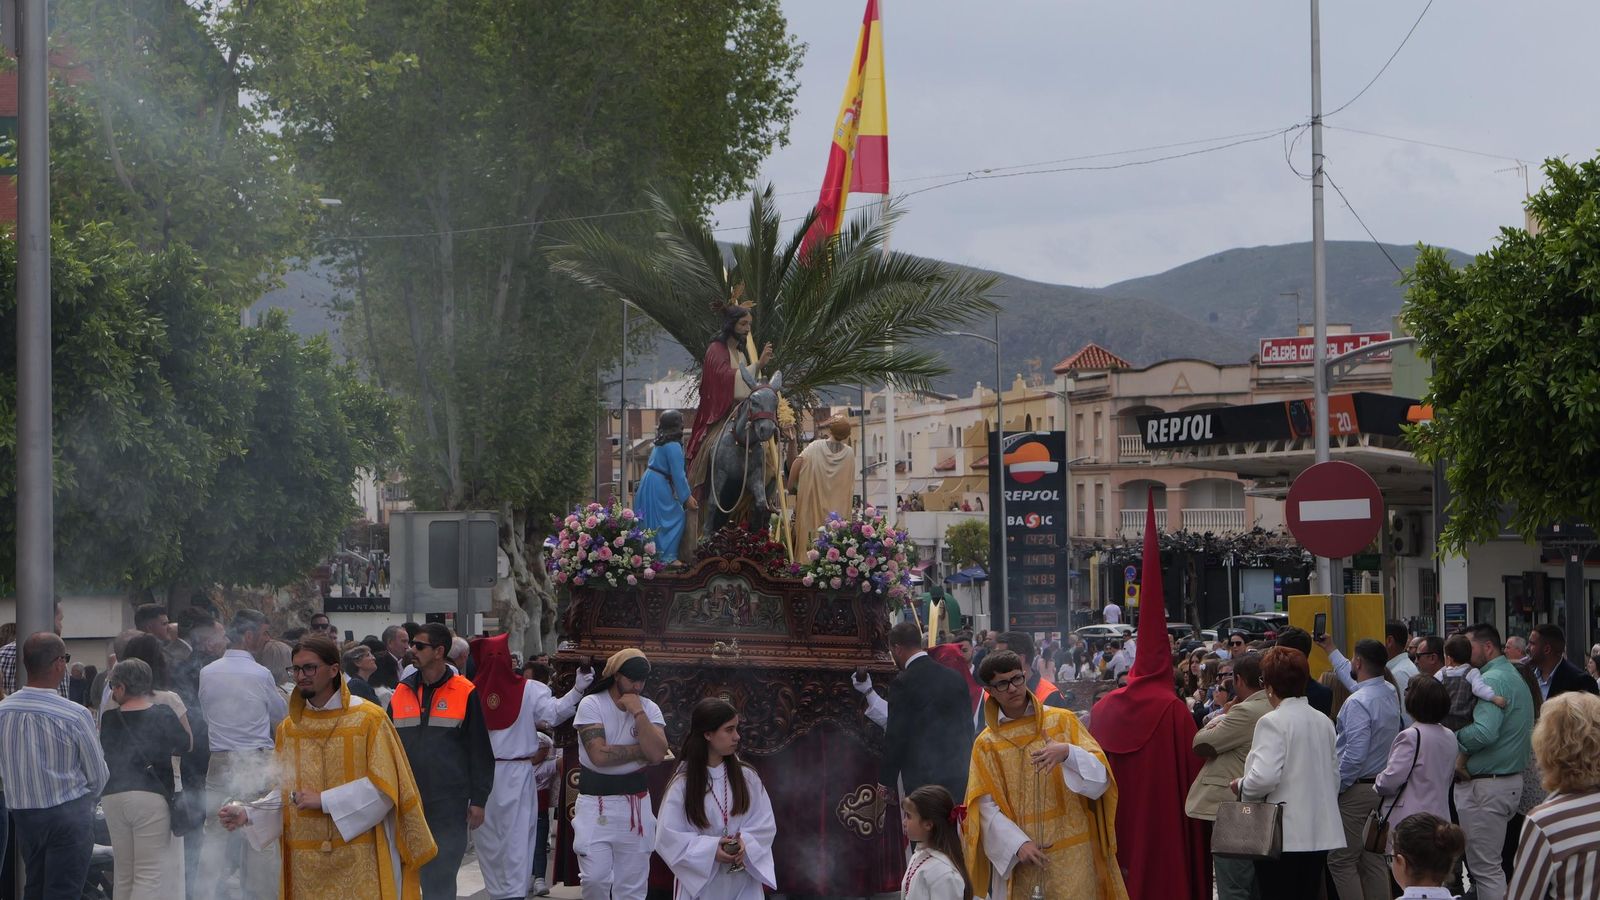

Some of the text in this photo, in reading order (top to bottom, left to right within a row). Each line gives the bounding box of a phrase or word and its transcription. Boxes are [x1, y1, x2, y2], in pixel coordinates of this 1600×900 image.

[1146, 414, 1213, 443] REPSOL
[1336, 412, 1351, 431] 20
[1004, 490, 1059, 501] REPSOL
[1007, 513, 1053, 527] BASIC
